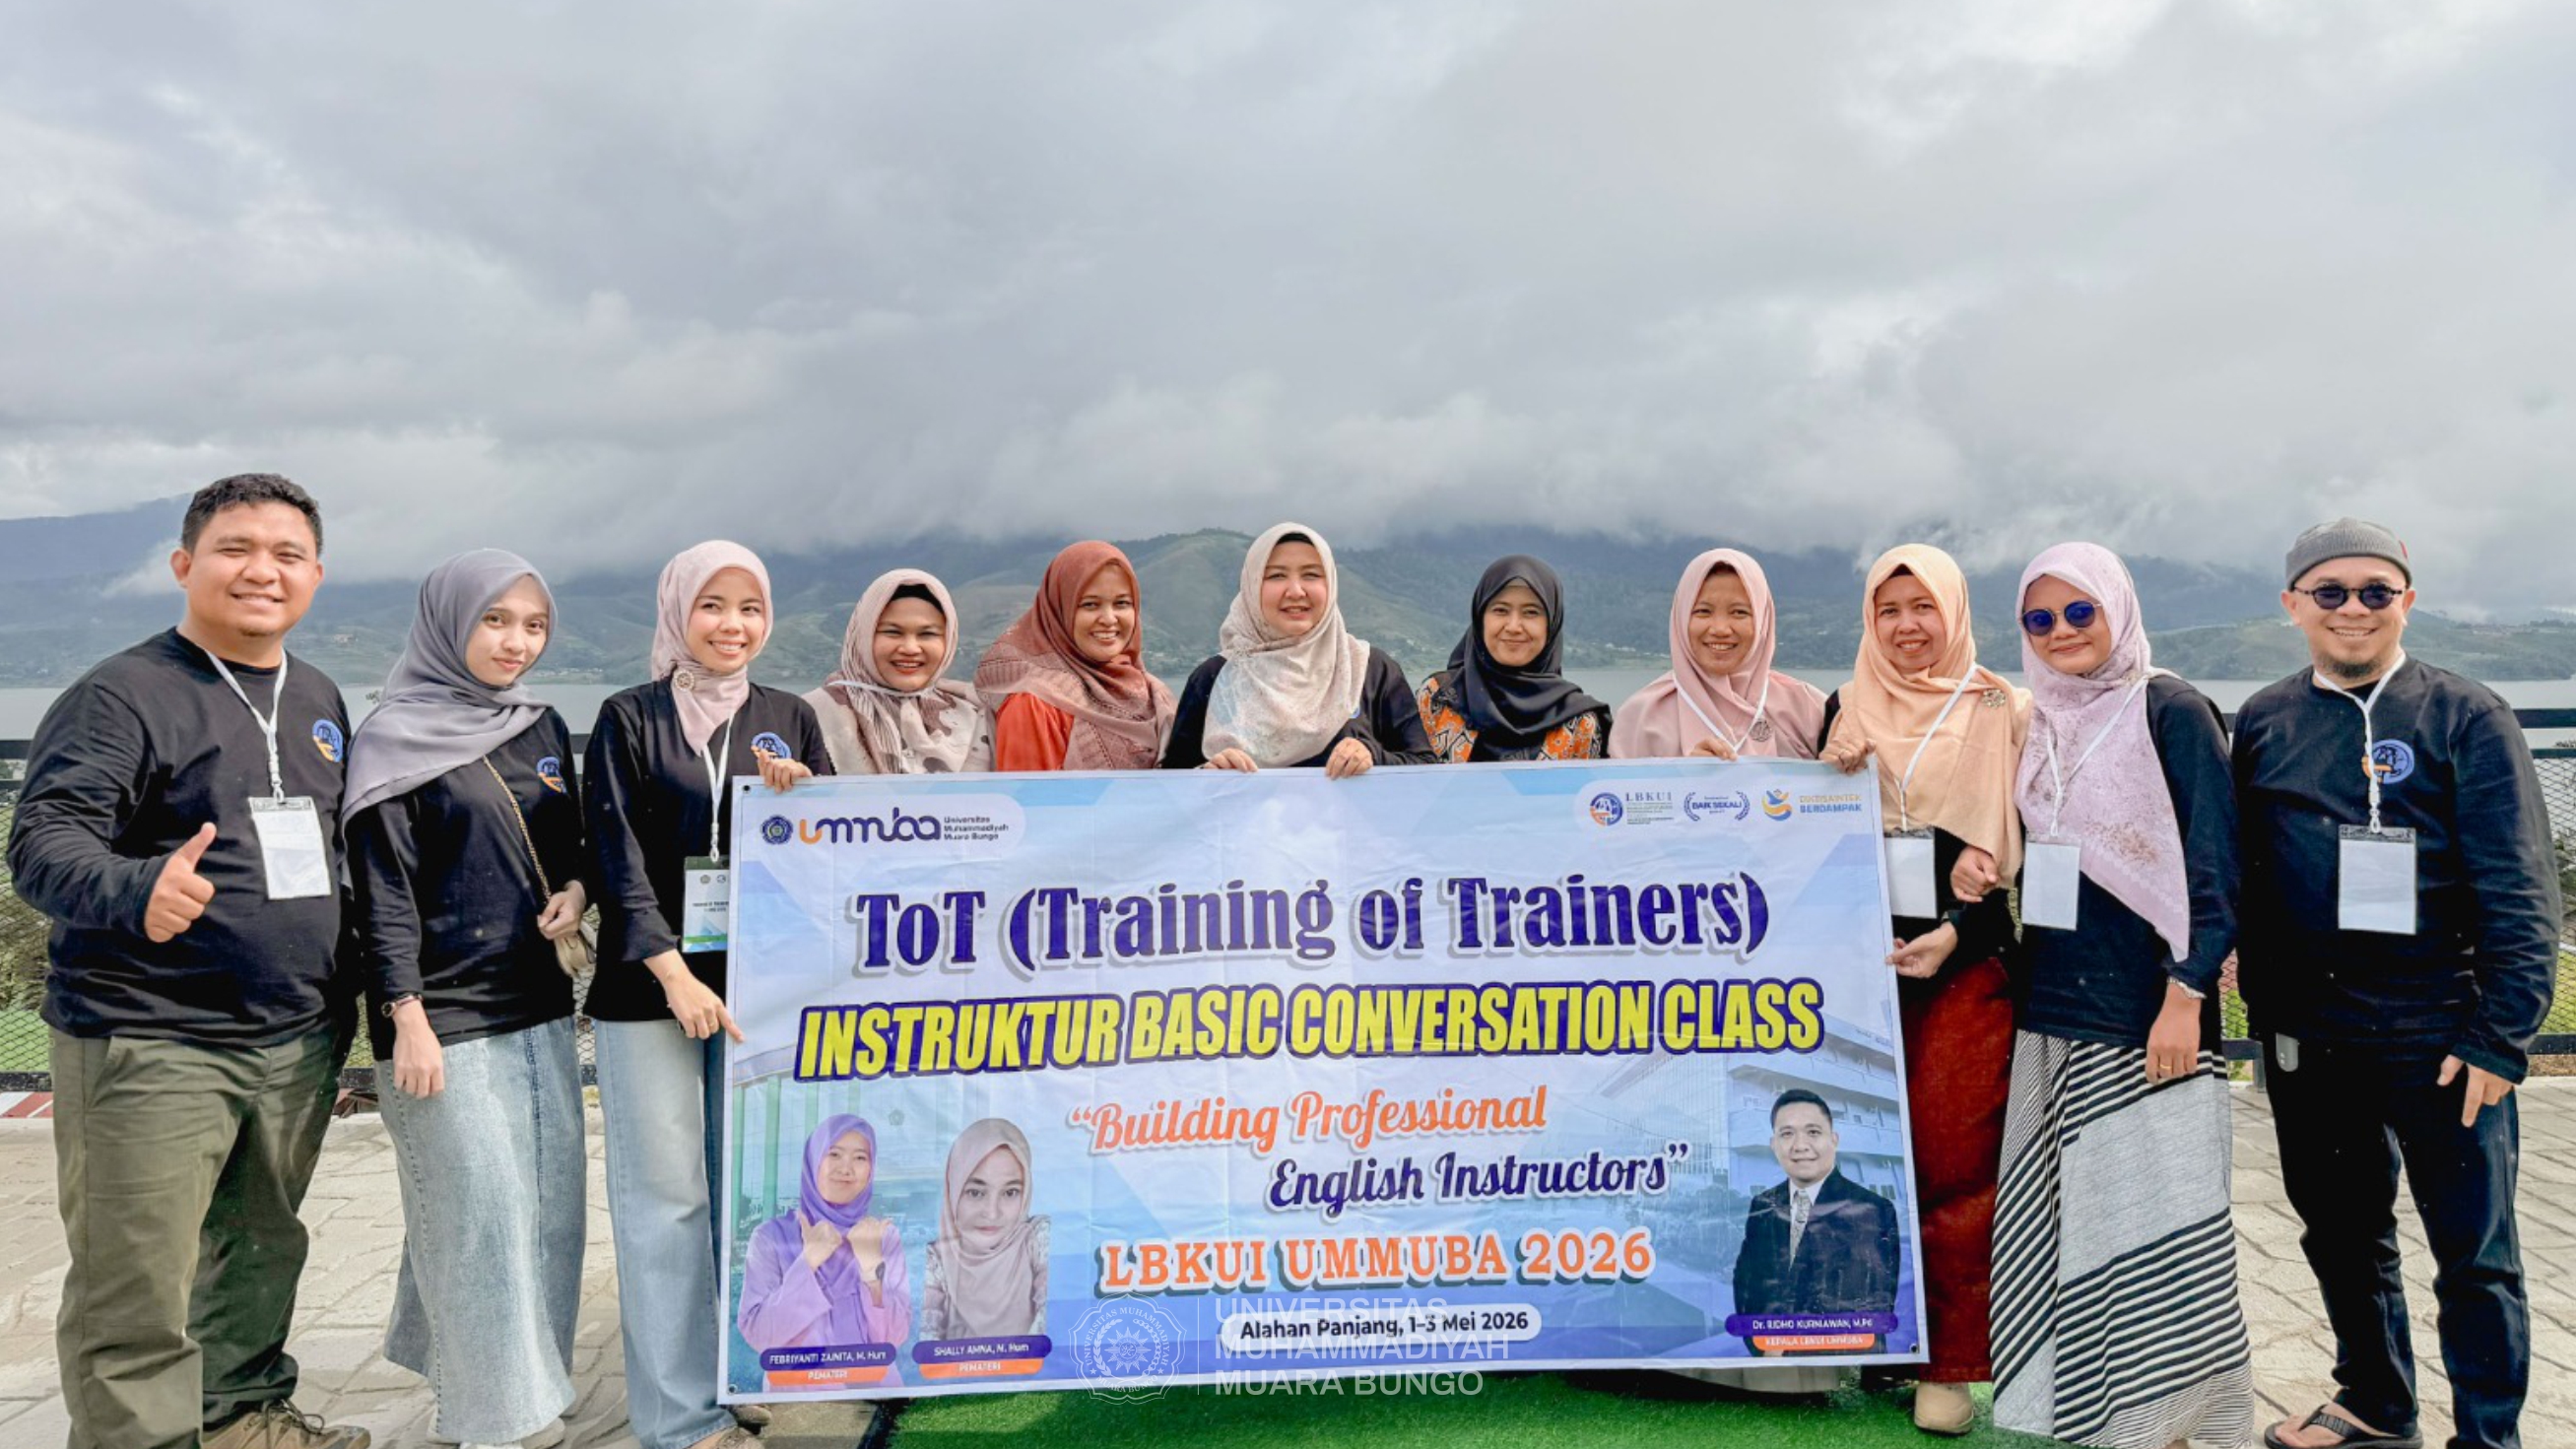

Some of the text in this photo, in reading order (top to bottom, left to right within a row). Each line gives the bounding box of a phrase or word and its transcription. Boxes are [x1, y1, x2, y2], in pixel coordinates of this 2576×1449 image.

[1625, 792, 1672, 802] LBKUI
[1800, 804, 1862, 813] BERDAMPAK
[857, 871, 1769, 972] ToT (Training of Trainers)
[796, 979, 1822, 1081] INSTRUKTUR BASIC CONVERSATION CLASS
[1071, 1085, 1548, 1152] “Building Professional
[1270, 1143, 1688, 1218] English Instructors”
[1103, 1231, 1652, 1286] LBKUI UMMUBA 2026
[1240, 1320, 1311, 1340] Alahan
[1317, 1315, 1404, 1339] Panjang,
[1442, 1311, 1476, 1332] Mei
[1482, 1311, 1529, 1331] 2026
[1752, 1320, 1765, 1330] Dr.
[769, 1353, 819, 1365] FEBRIYANTI
[934, 1346, 964, 1356] SHALLY
